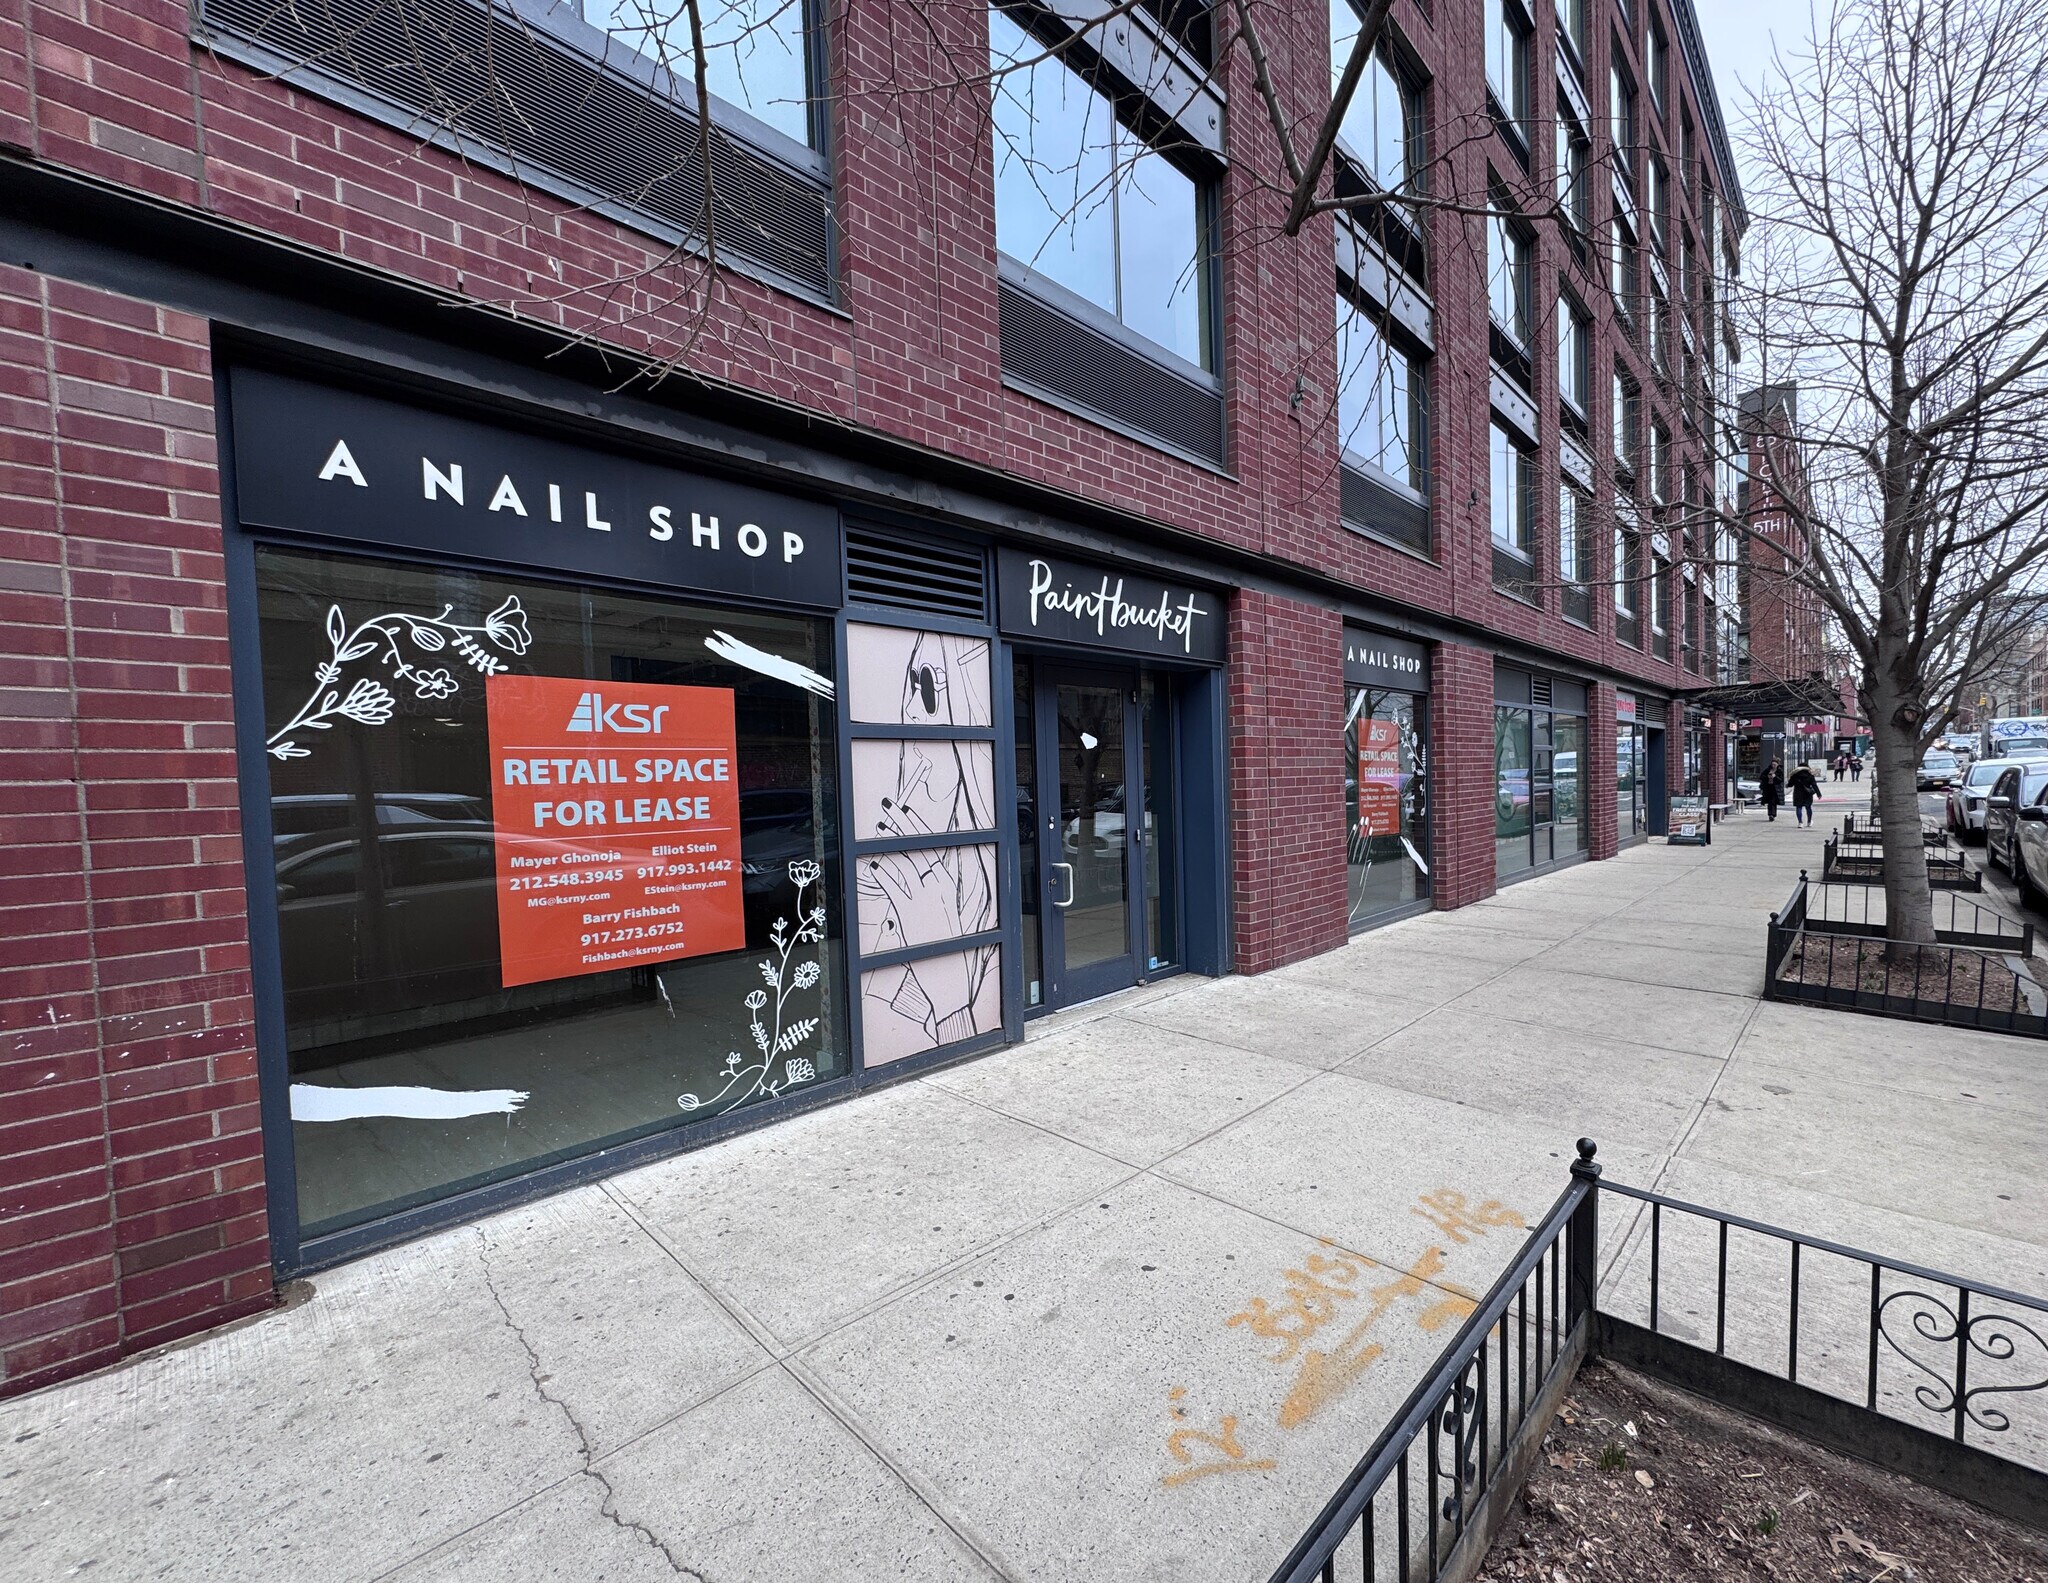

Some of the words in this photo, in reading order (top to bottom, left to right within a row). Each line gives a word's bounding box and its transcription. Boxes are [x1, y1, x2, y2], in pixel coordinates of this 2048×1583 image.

[318, 439, 369, 487] A
[422, 456, 612, 532] NAIL
[649, 505, 804, 563] SHOP
[1753, 518, 1780, 534] 5TH
[1028, 559, 1208, 654] Paintbucket
[1347, 645, 1355, 662] A
[1360, 647, 1389, 668] NAIL
[1392, 654, 1421, 674] SHOP
[1360, 750, 1380, 761] RETAIL
[1381, 751, 1398, 762] SPACE
[503, 758, 628, 786] RETAIL
[634, 758, 730, 783] SPACE
[1364, 766, 1380, 778] FOR
[1380, 766, 1395, 778] LEASE
[533, 801, 608, 828] FOR
[615, 796, 711, 824] LEASE
[510, 855, 559, 871] Mayer
[561, 850, 623, 865] Ghonoja
[652, 844, 685, 857] Elliot
[686, 842, 718, 855] Stein
[509, 869, 624, 891] 212.548.3945
[637, 860, 732, 880] 917.993.1442
[644, 879, 727, 895] EStein@ksrny.com
[527, 891, 611, 908] MG@ksrny.com
[583, 909, 622, 925] Barry
[623, 903, 681, 920] Fishbach
[580, 922, 684, 946] 917.273.6752
[582, 940, 685, 964] Fishbach@ksrny.com
